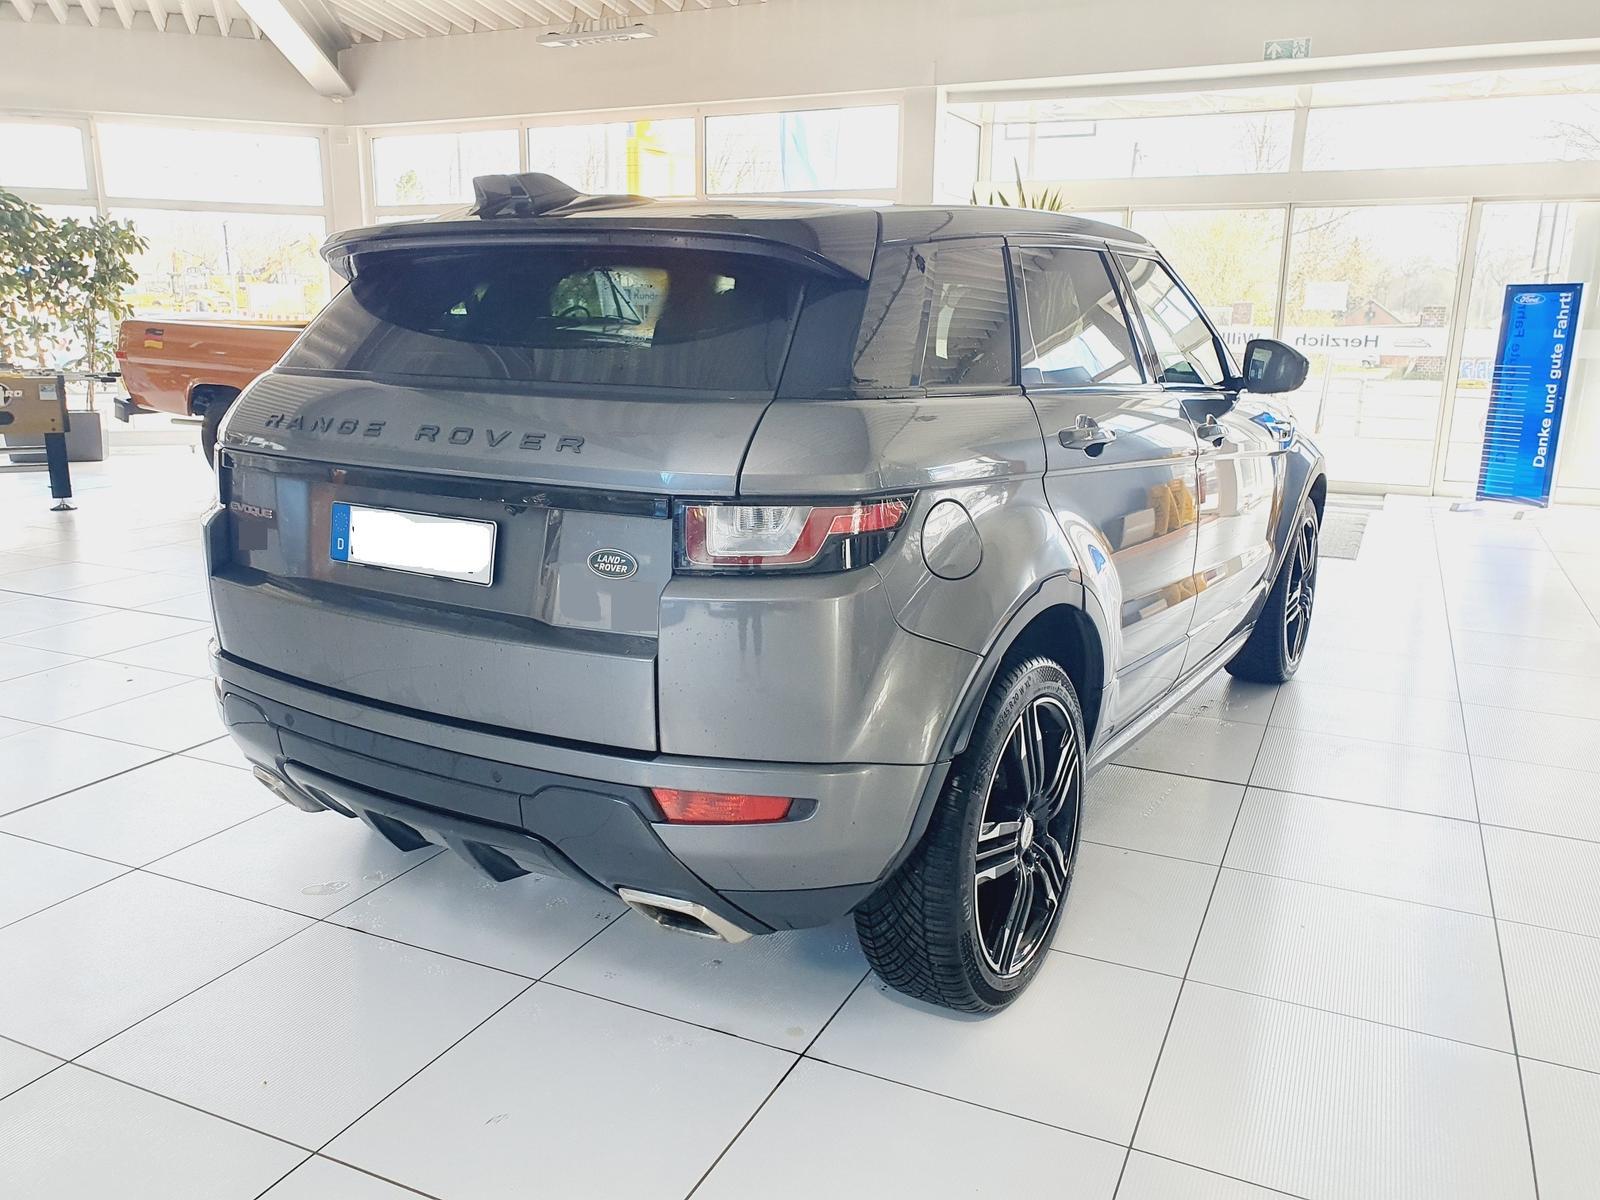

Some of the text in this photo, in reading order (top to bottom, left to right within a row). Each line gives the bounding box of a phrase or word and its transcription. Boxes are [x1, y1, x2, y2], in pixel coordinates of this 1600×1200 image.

[1532, 292, 1572, 468] Danke und gute Fahrt!
[264, 413, 586, 454] RANGE ROVER
[230, 501, 273, 519] EVOQUE
[337, 537, 345, 550] D
